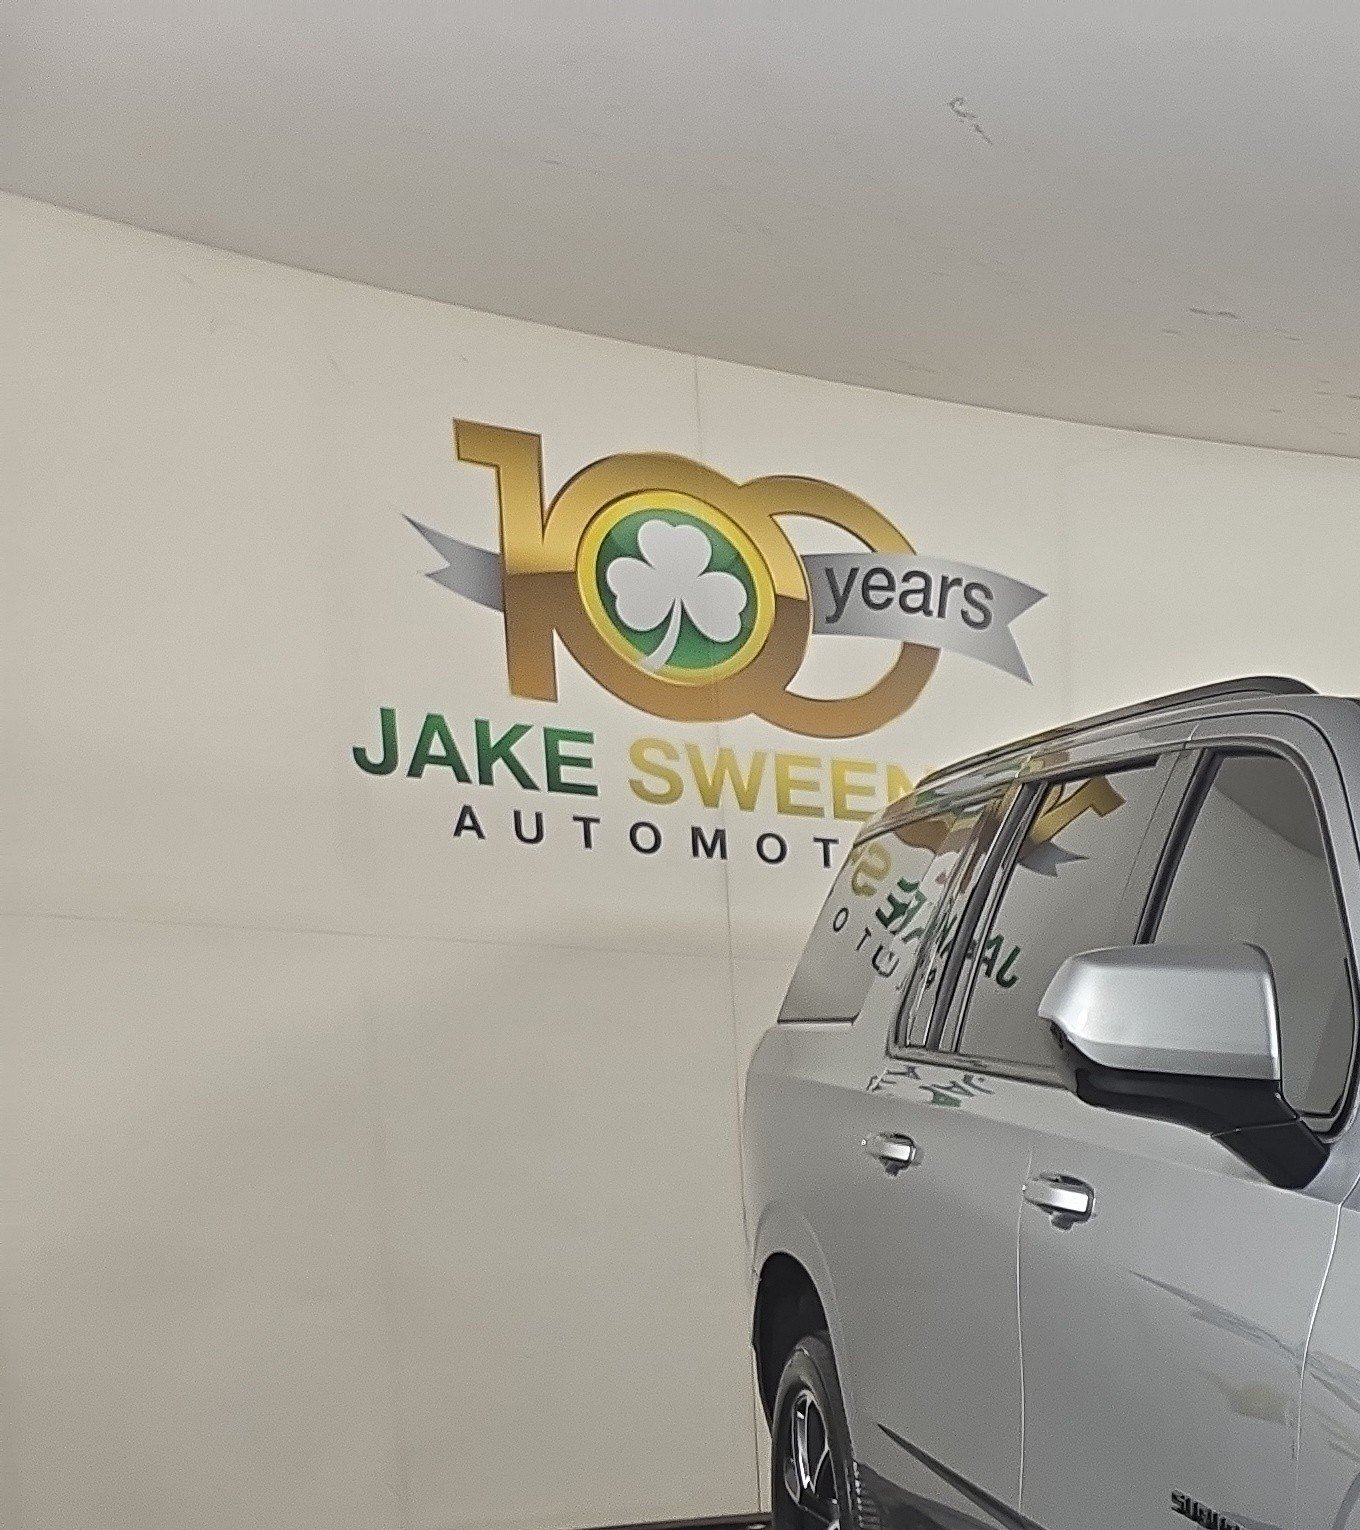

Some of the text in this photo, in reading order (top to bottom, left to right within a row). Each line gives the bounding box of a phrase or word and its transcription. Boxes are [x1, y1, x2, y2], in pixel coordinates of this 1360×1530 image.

[453, 418, 995, 739] 100 years
[352, 706, 599, 797] JAKE
[453, 804, 840, 869] AUTOMOT
